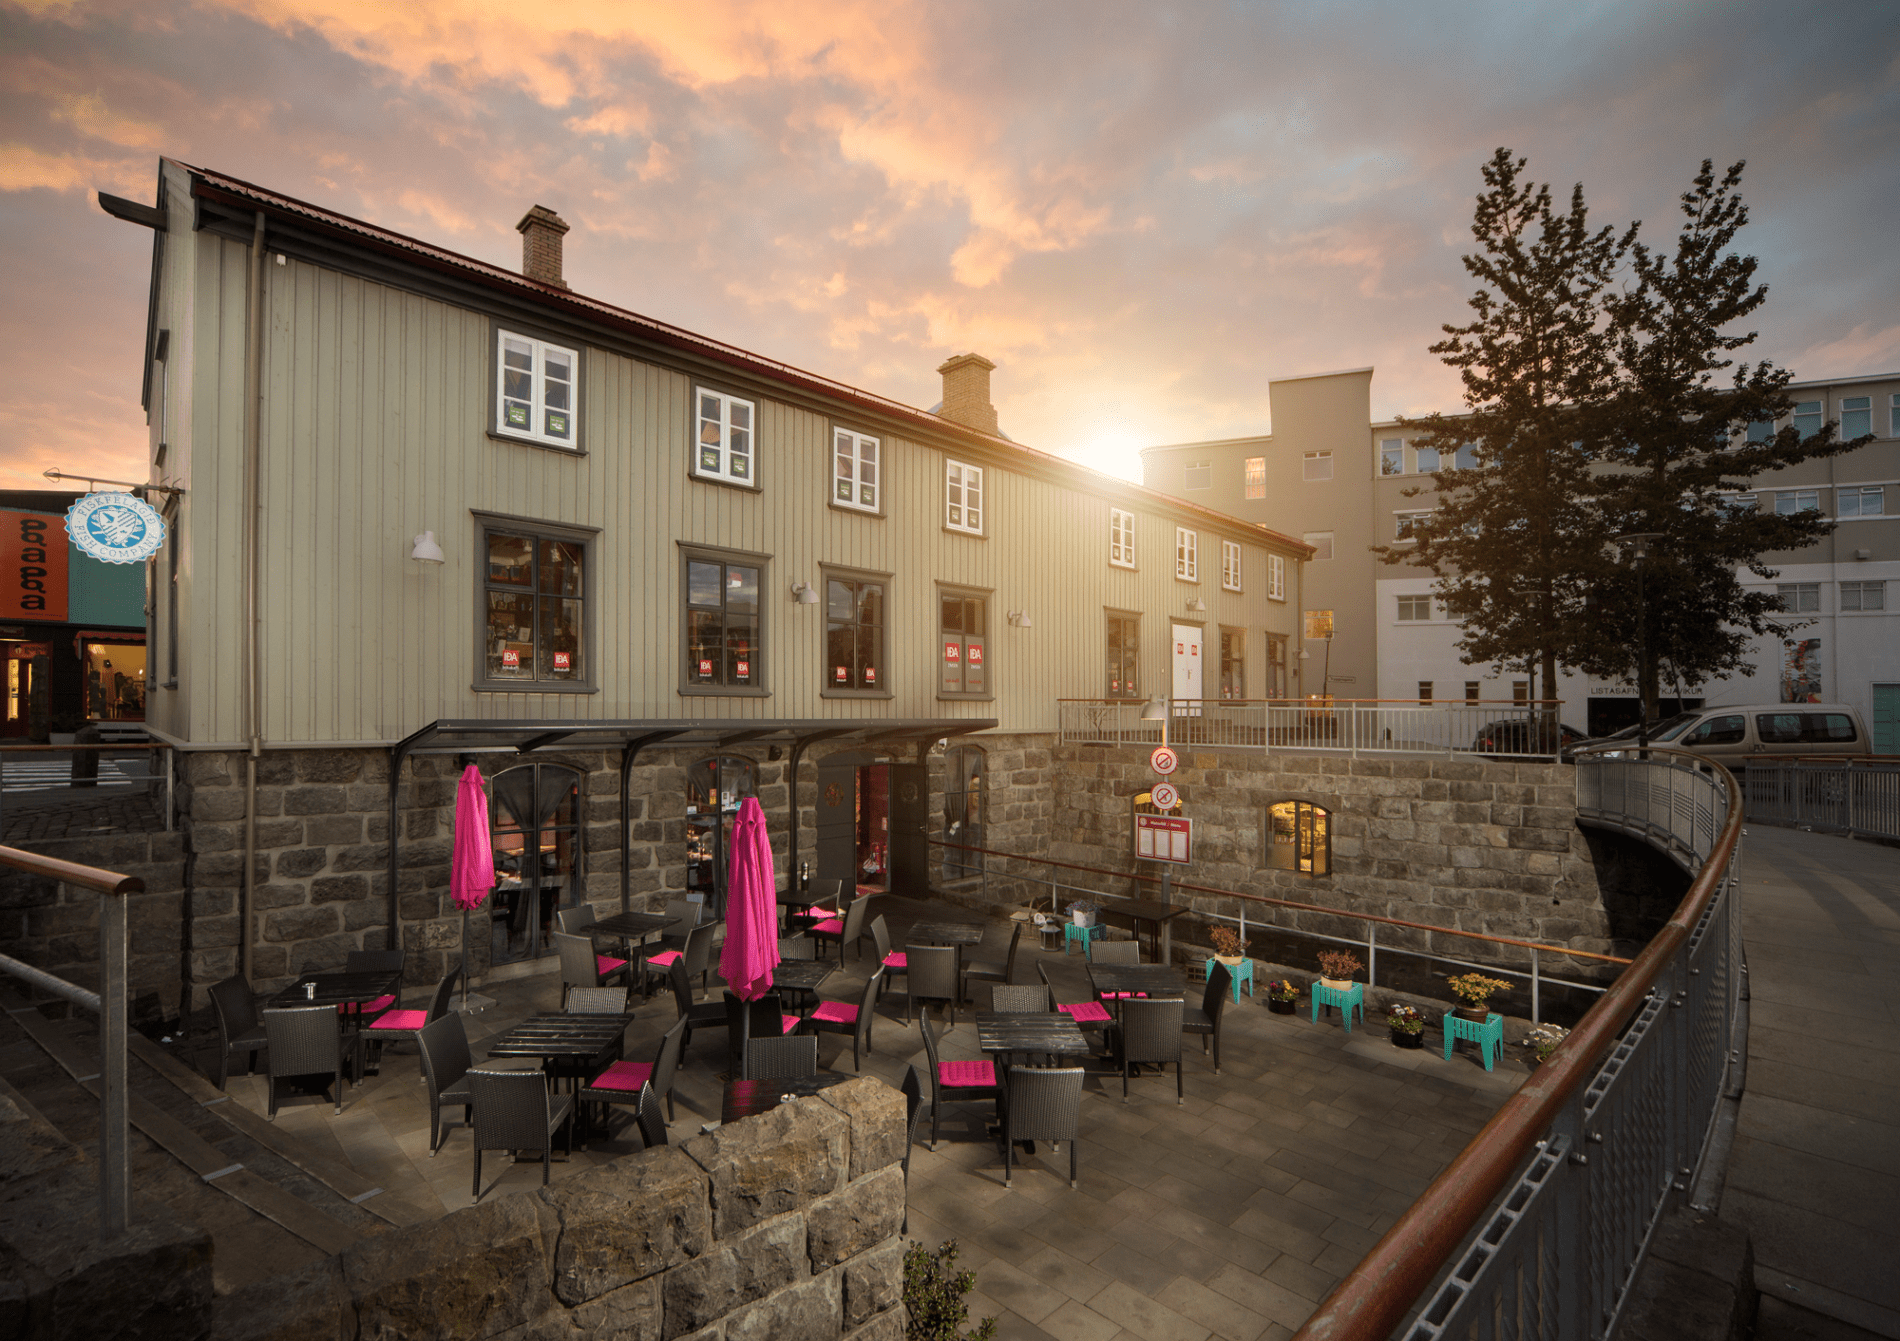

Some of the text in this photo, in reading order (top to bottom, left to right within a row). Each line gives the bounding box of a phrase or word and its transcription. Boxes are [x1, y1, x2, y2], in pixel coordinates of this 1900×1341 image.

[74, 525, 158, 558] FISH COMPANY
[1590, 687, 1639, 695] LISTASAFN
